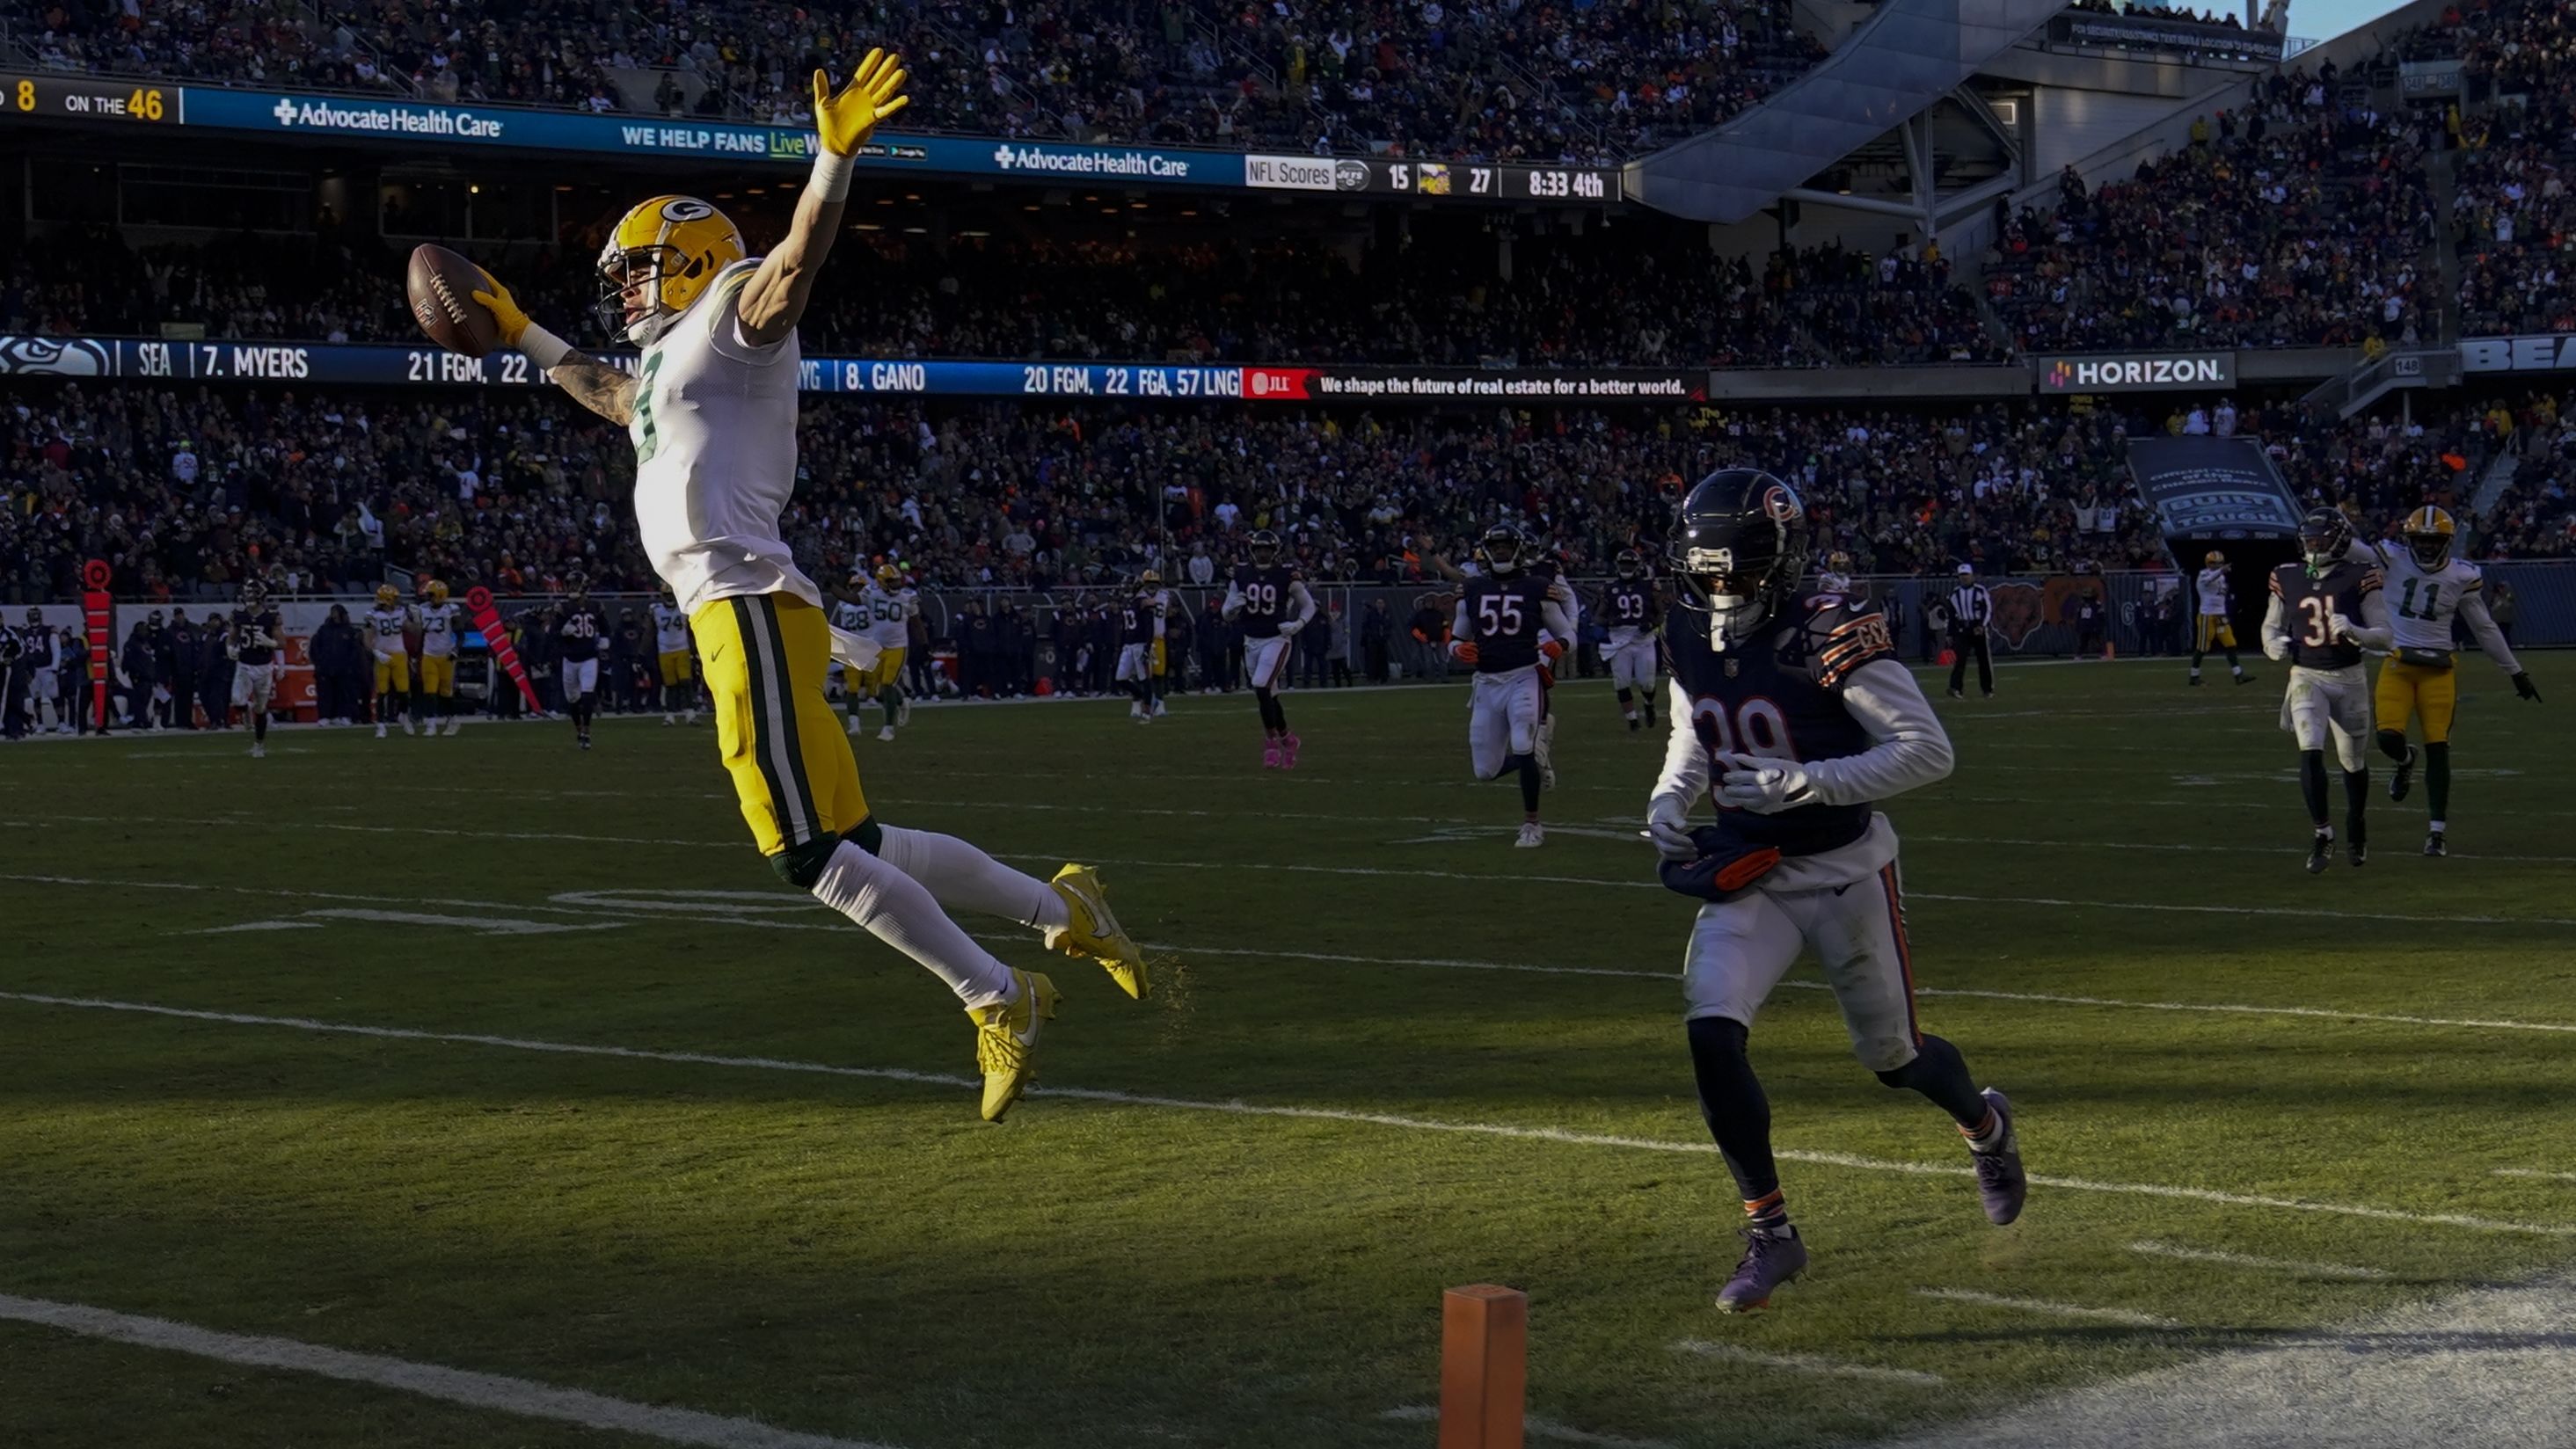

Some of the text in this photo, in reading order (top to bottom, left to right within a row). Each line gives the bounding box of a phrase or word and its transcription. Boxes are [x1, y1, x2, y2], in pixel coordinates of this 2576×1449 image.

[17, 79, 36, 112] 8
[65, 95, 89, 113] ON
[94, 97, 125, 115] THE
[128, 89, 163, 120] 46
[299, 102, 501, 137] Advocate Health Care
[622, 127, 822, 155] WE HELP FANS LiveW
[1016, 148, 1187, 177] Advocate Health Care
[1249, 160, 1331, 186] NFL Scores
[1389, 165, 1409, 190] 15
[1470, 169, 1491, 193] 27
[1529, 171, 1603, 198] 8:33 4th
[139, 343, 172, 376] SEA
[202, 346, 308, 378] 7. MYERS
[408, 352, 434, 381] 21
[441, 353, 487, 384] FGM,
[501, 354, 527, 384] 22
[2397, 360, 2419, 372] 148
[845, 362, 925, 391] 8. GANO
[1024, 366, 1239, 397] 20 FGM, 22 FGA, 57 LNG
[1321, 376, 1685, 396] We shape the future of real estate for a better world.
[2169, 494, 2267, 512] BUILT
[2177, 513, 2280, 528] TOUGH
[873, 600, 902, 622] 50
[1244, 583, 1277, 615] 99
[1616, 593, 1644, 619] 93
[2398, 577, 2441, 621] 11
[380, 617, 402, 636] 85
[423, 616, 445, 633] 73
[573, 614, 595, 639] 36
[660, 616, 682, 632] 74
[846, 610, 870, 630] 28
[1478, 593, 1524, 637] 55
[25, 634, 45, 654] 94
[1693, 695, 1798, 812] 39
